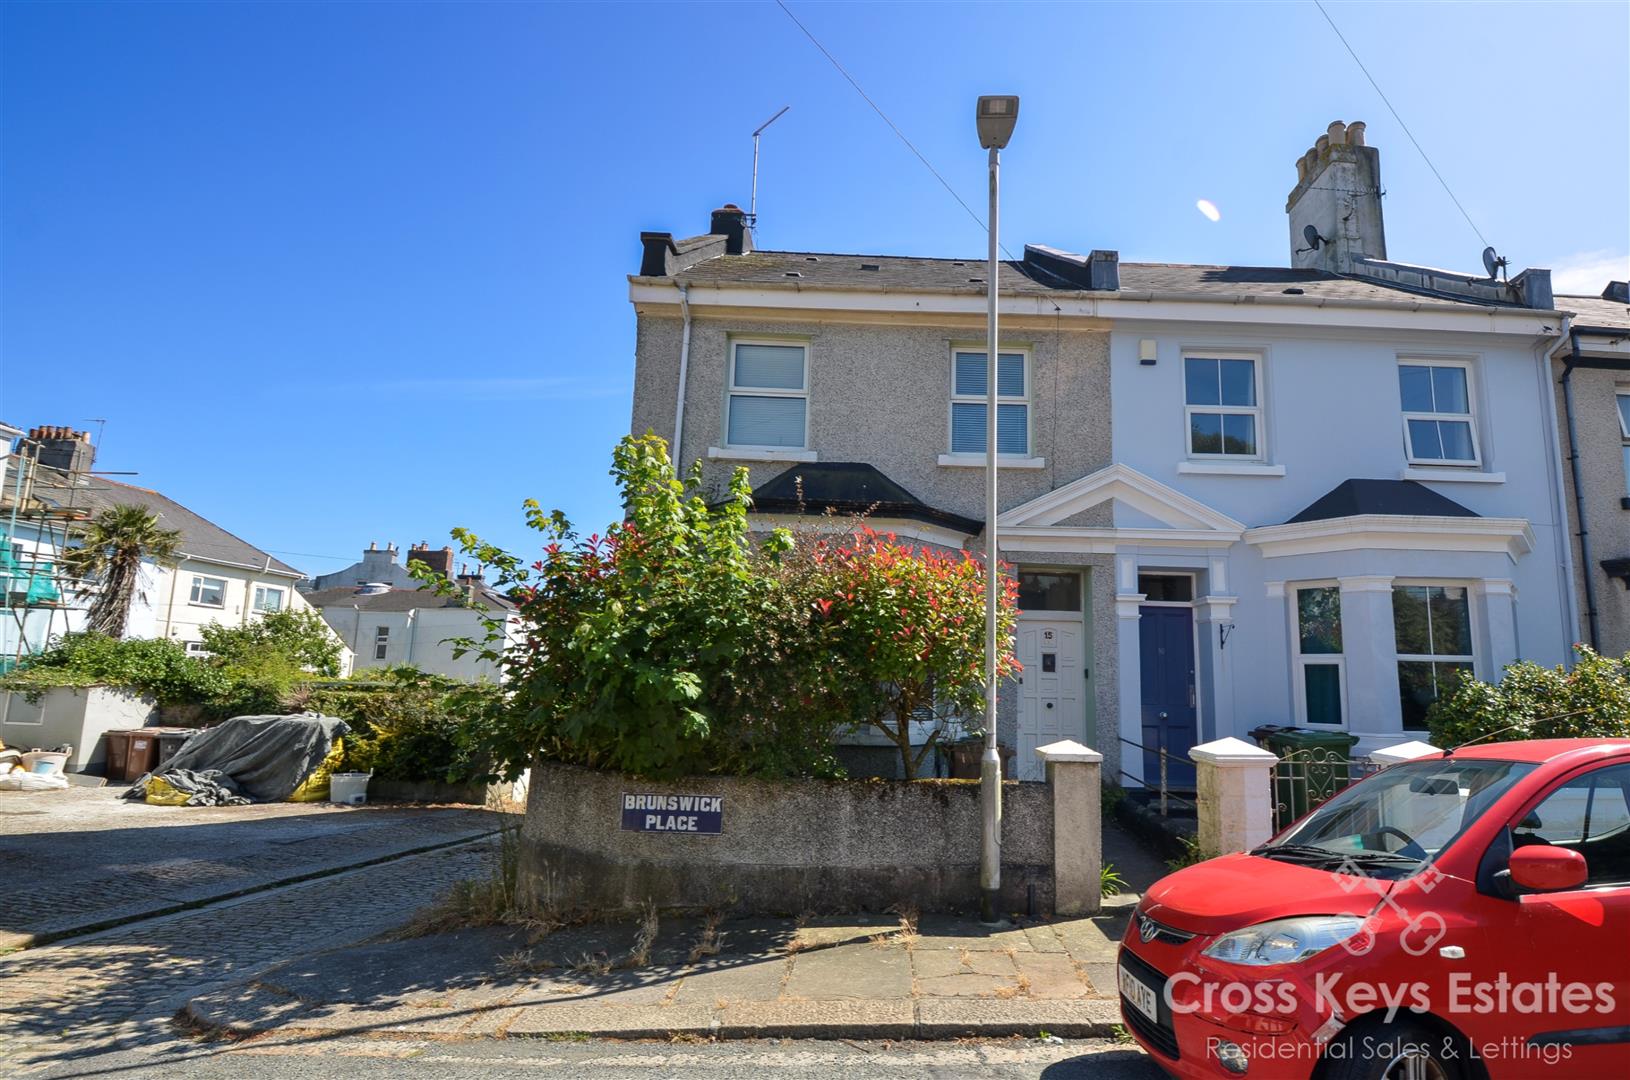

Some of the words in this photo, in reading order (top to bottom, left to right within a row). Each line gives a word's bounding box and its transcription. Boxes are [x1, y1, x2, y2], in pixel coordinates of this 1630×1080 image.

[1044, 631, 1053, 640] 15
[624, 794, 722, 813] BRUNSWICK
[645, 814, 698, 831] PLACE
